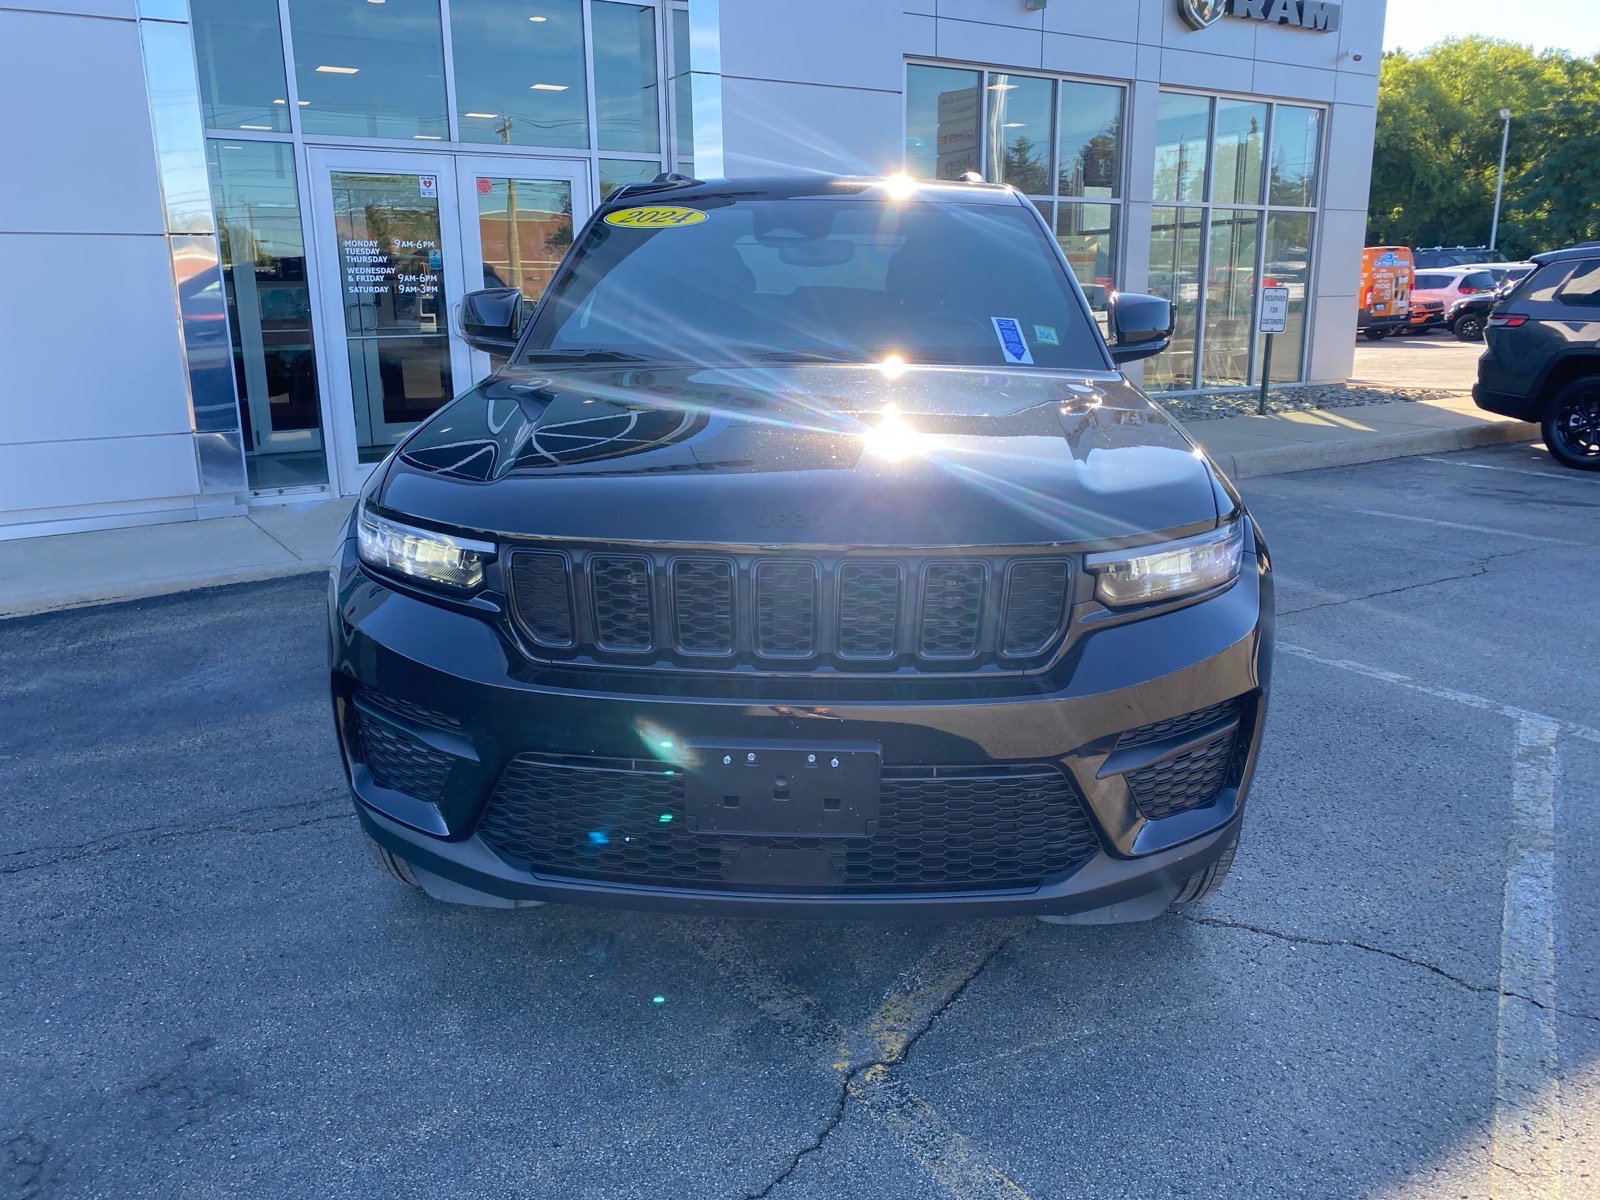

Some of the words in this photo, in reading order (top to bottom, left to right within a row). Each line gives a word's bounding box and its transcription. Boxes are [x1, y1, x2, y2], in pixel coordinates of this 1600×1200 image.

[1230, 0, 1341, 32] RAM
[617, 210, 695, 224] 2024
[344, 240, 379, 248] MONDAY
[752, 507, 825, 534] Jeep
